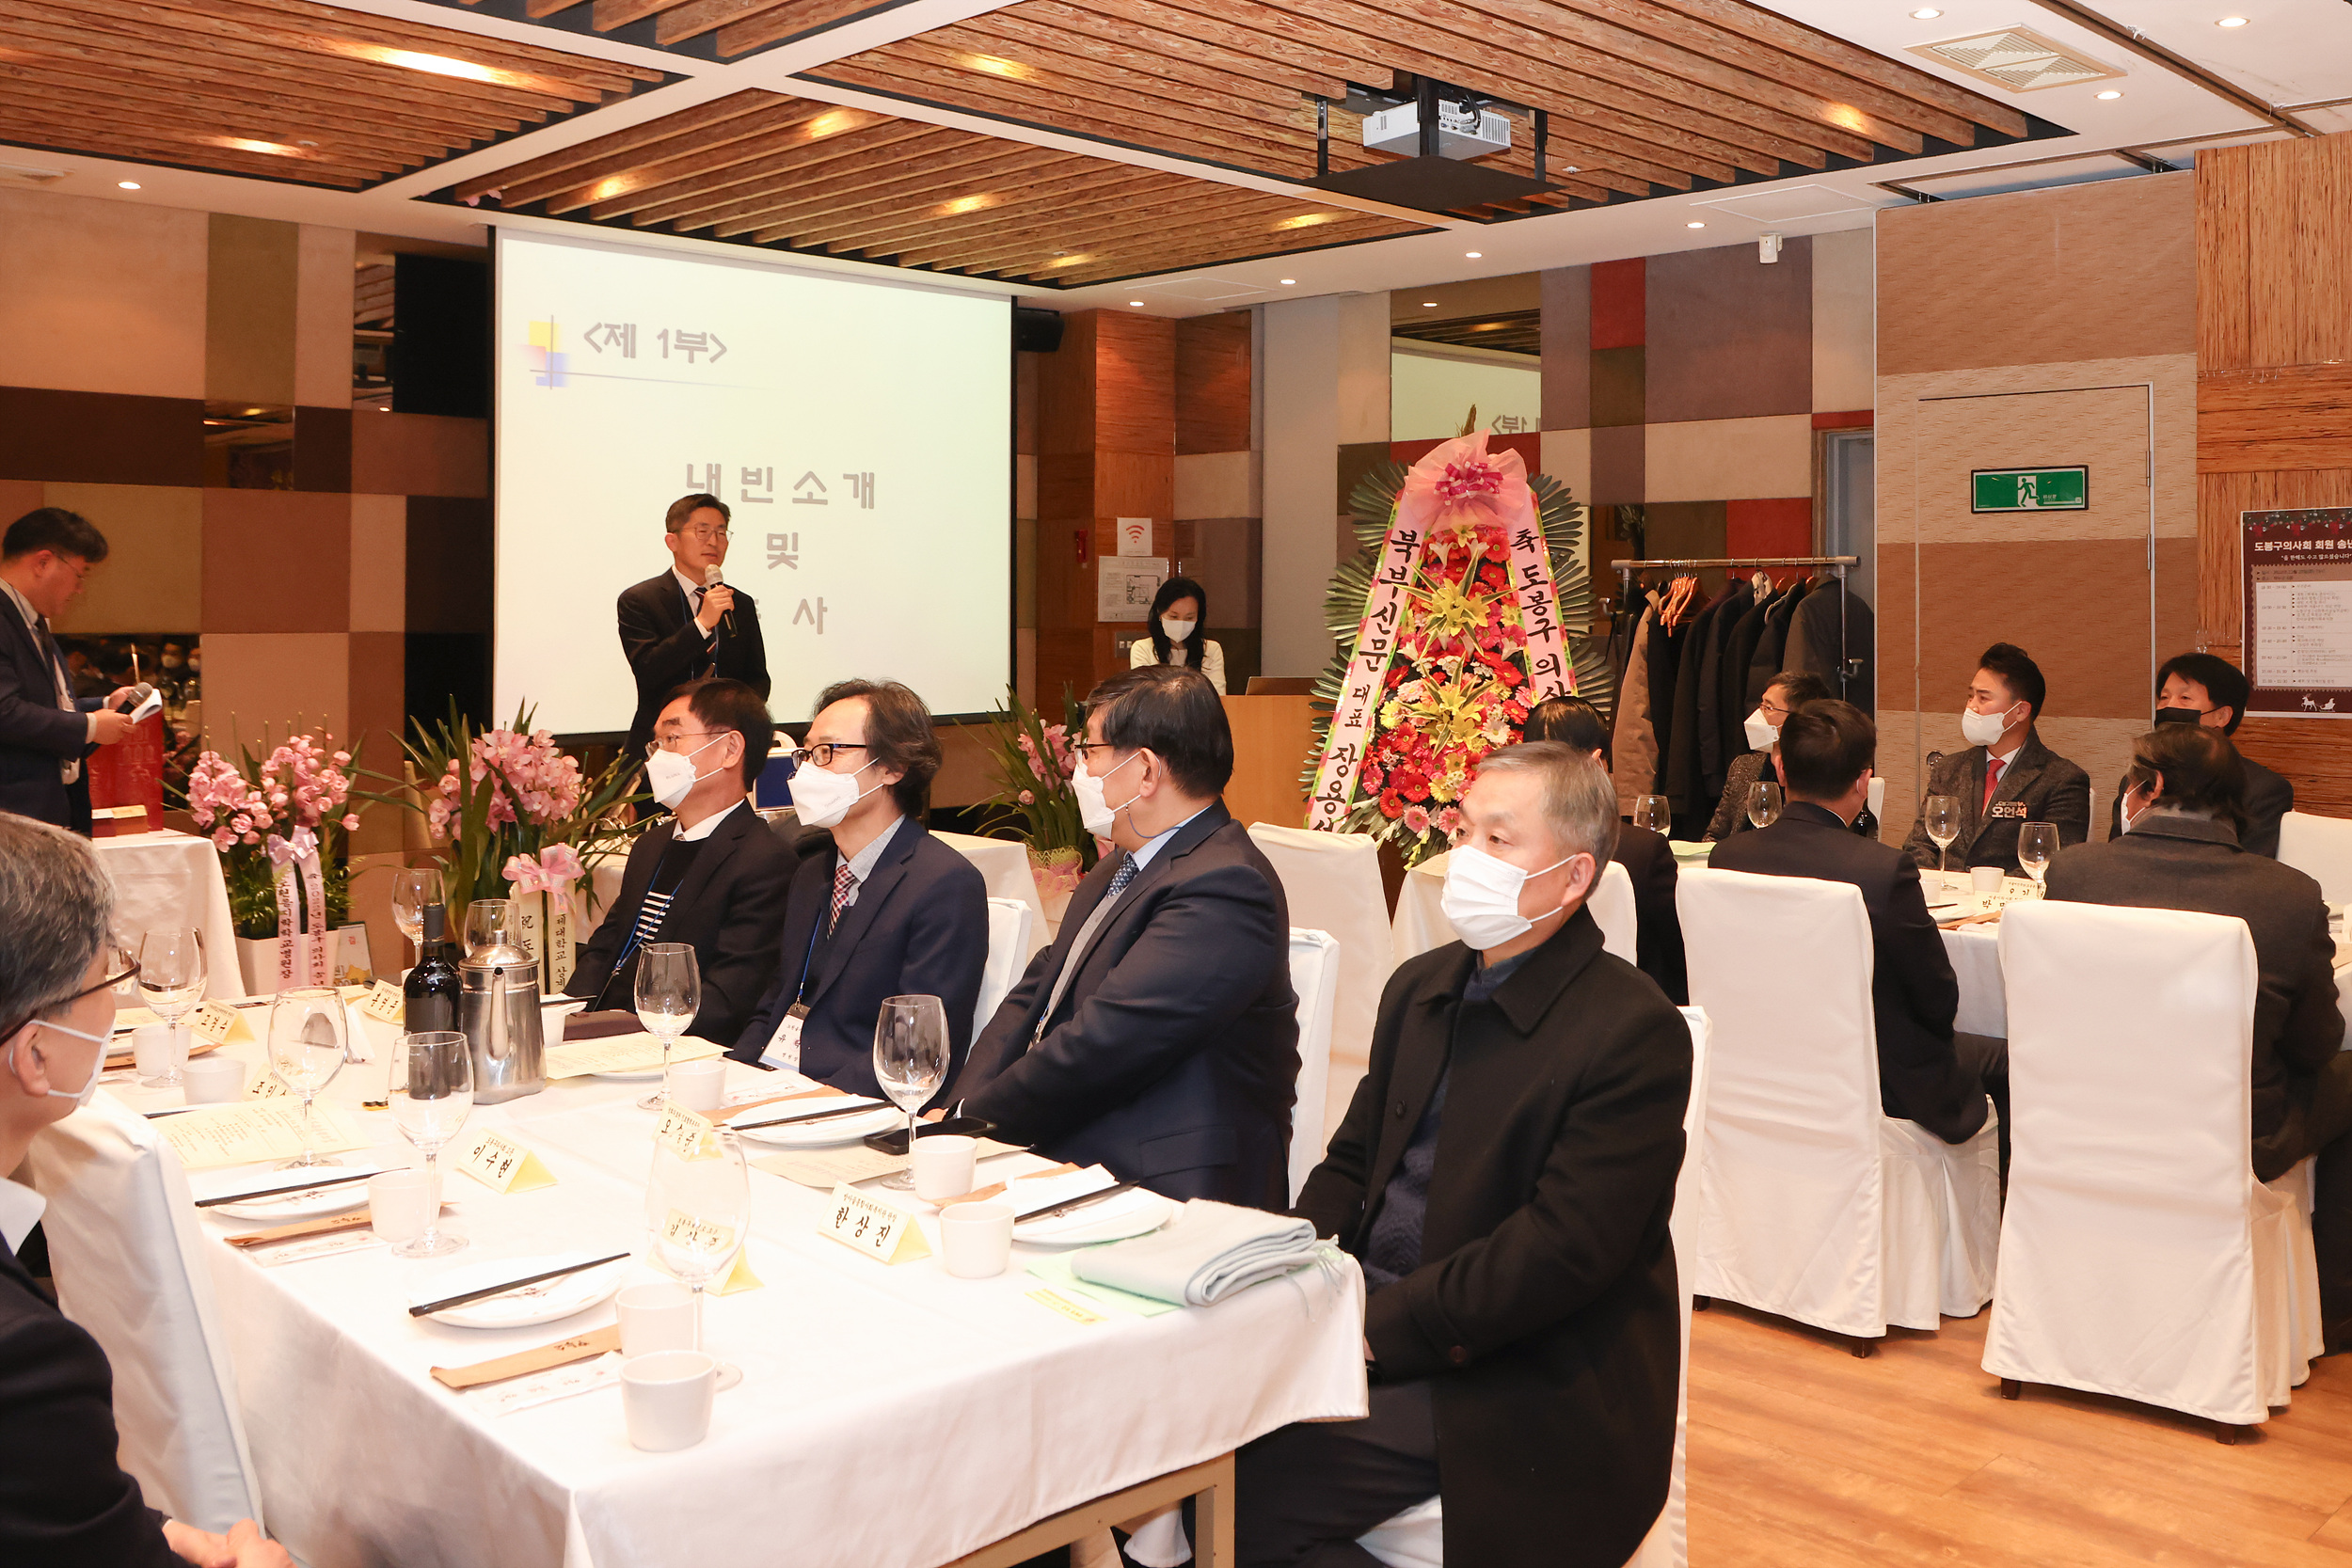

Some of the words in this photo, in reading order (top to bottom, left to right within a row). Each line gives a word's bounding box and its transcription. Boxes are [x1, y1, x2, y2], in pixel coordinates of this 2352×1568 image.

[582, 322, 637, 359] <제
[657, 327, 728, 364] 1부>
[766, 531, 800, 570] 및
[1509, 529, 1539, 554] 축
[2254, 540, 2312, 552] 도봉구의사회
[2314, 539, 2334, 550] 회원
[1358, 529, 1421, 672] 북부신문
[1518, 564, 1558, 642] 도봉구
[1343, 683, 1372, 729] 대표
[1991, 806, 2027, 819] 오언석
[472, 1144, 514, 1178] 이수현
[835, 1206, 891, 1247] 한상진
